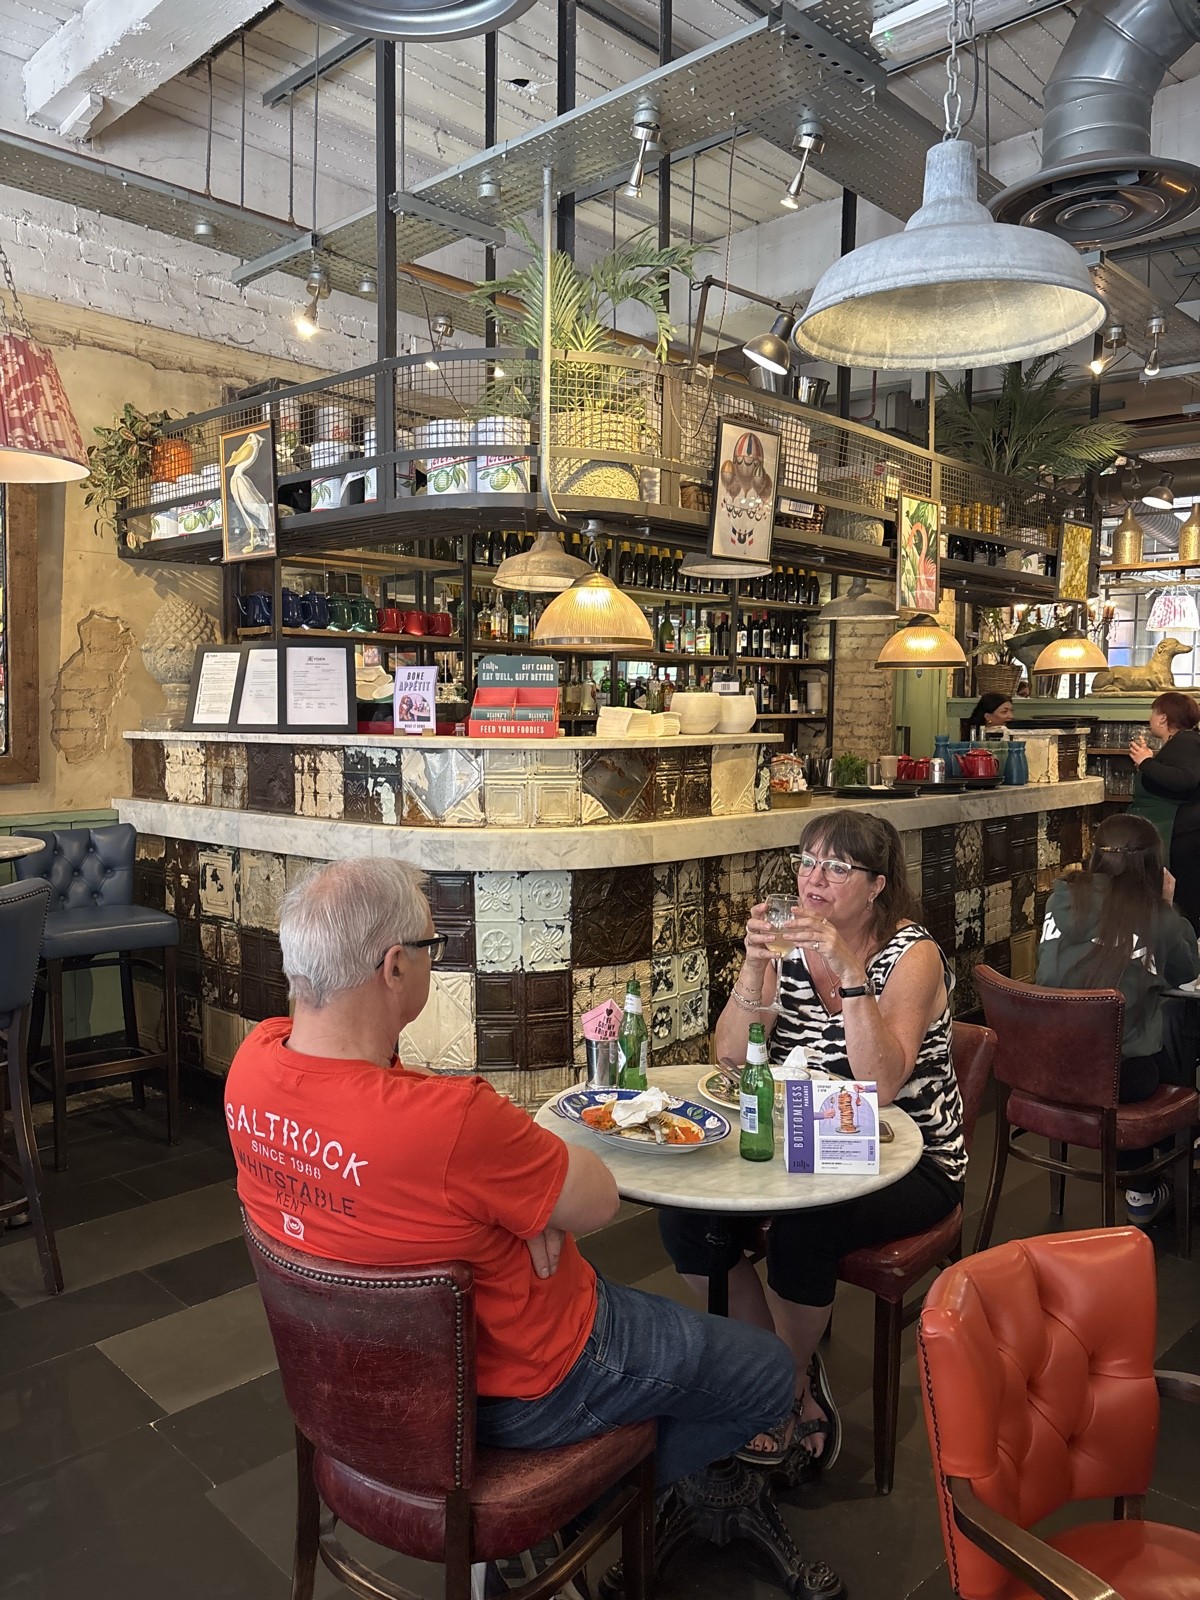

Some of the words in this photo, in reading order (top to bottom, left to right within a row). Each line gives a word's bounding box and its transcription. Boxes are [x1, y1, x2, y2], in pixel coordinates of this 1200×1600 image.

[407, 672, 424, 680] BONE
[482, 673, 493, 681] EAT
[495, 673, 513, 681] WELL,
[515, 673, 530, 681] GIFT
[531, 673, 554, 681] BETTER
[480, 725, 496, 733] FEED
[498, 725, 515, 733] YOUR
[517, 725, 544, 734] FOODIES
[792, 1085, 804, 1148] BOTTOMLESS
[226, 1103, 369, 1187] SALTROCK
[251, 1140, 286, 1165] SINCE
[290, 1157, 322, 1180] 1988
[237, 1147, 357, 1218] WHITSTABLE
[275, 1190, 308, 1216] KENT
